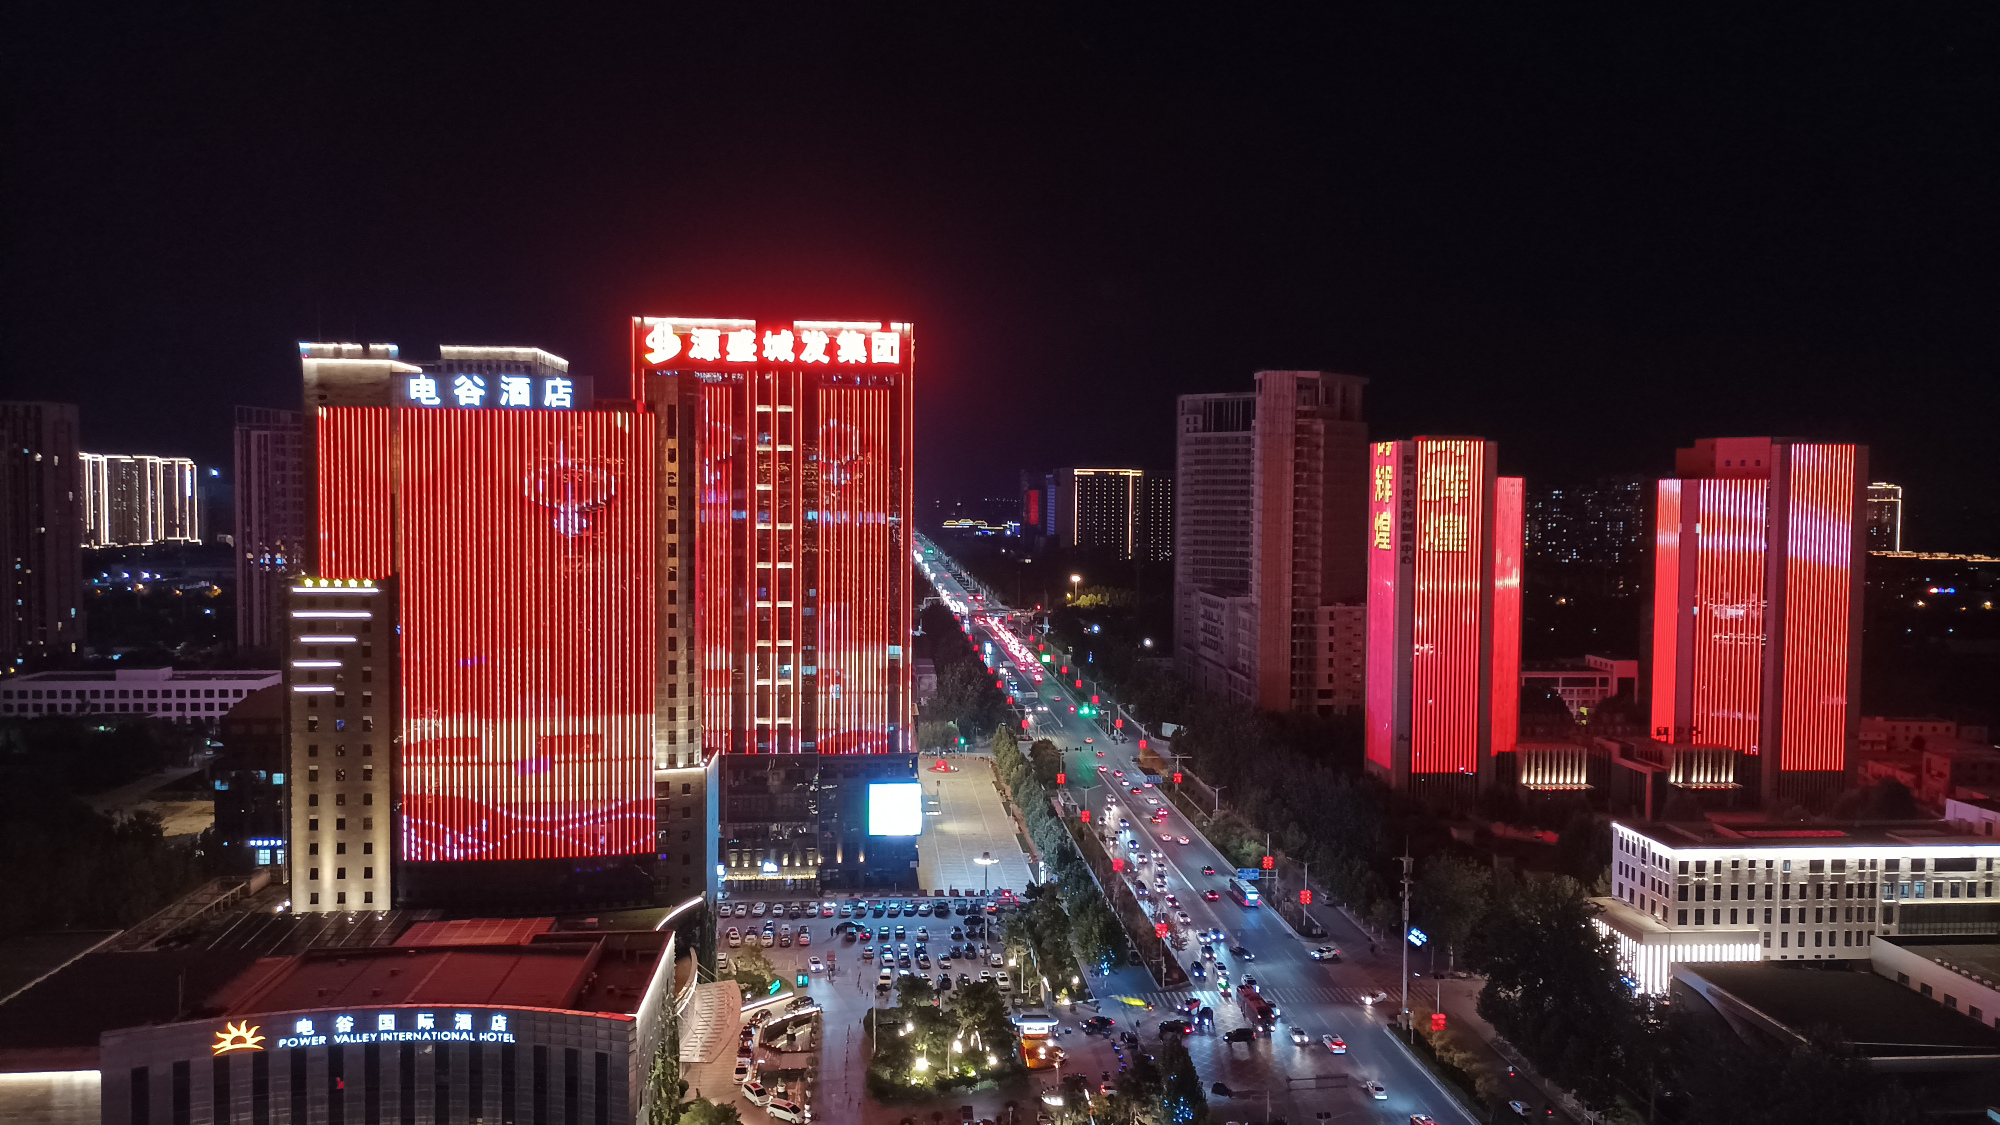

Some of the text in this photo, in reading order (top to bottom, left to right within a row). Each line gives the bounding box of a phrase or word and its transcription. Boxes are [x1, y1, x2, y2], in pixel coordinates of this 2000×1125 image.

[688, 328, 900, 364] 源盛城发集团
[409, 374, 573, 408] 电谷酒店
[296, 1013, 507, 1036] 电谷国际酒店
[278, 1031, 516, 1048] POWER VALLEY INTERNATIONAL HOTEL
